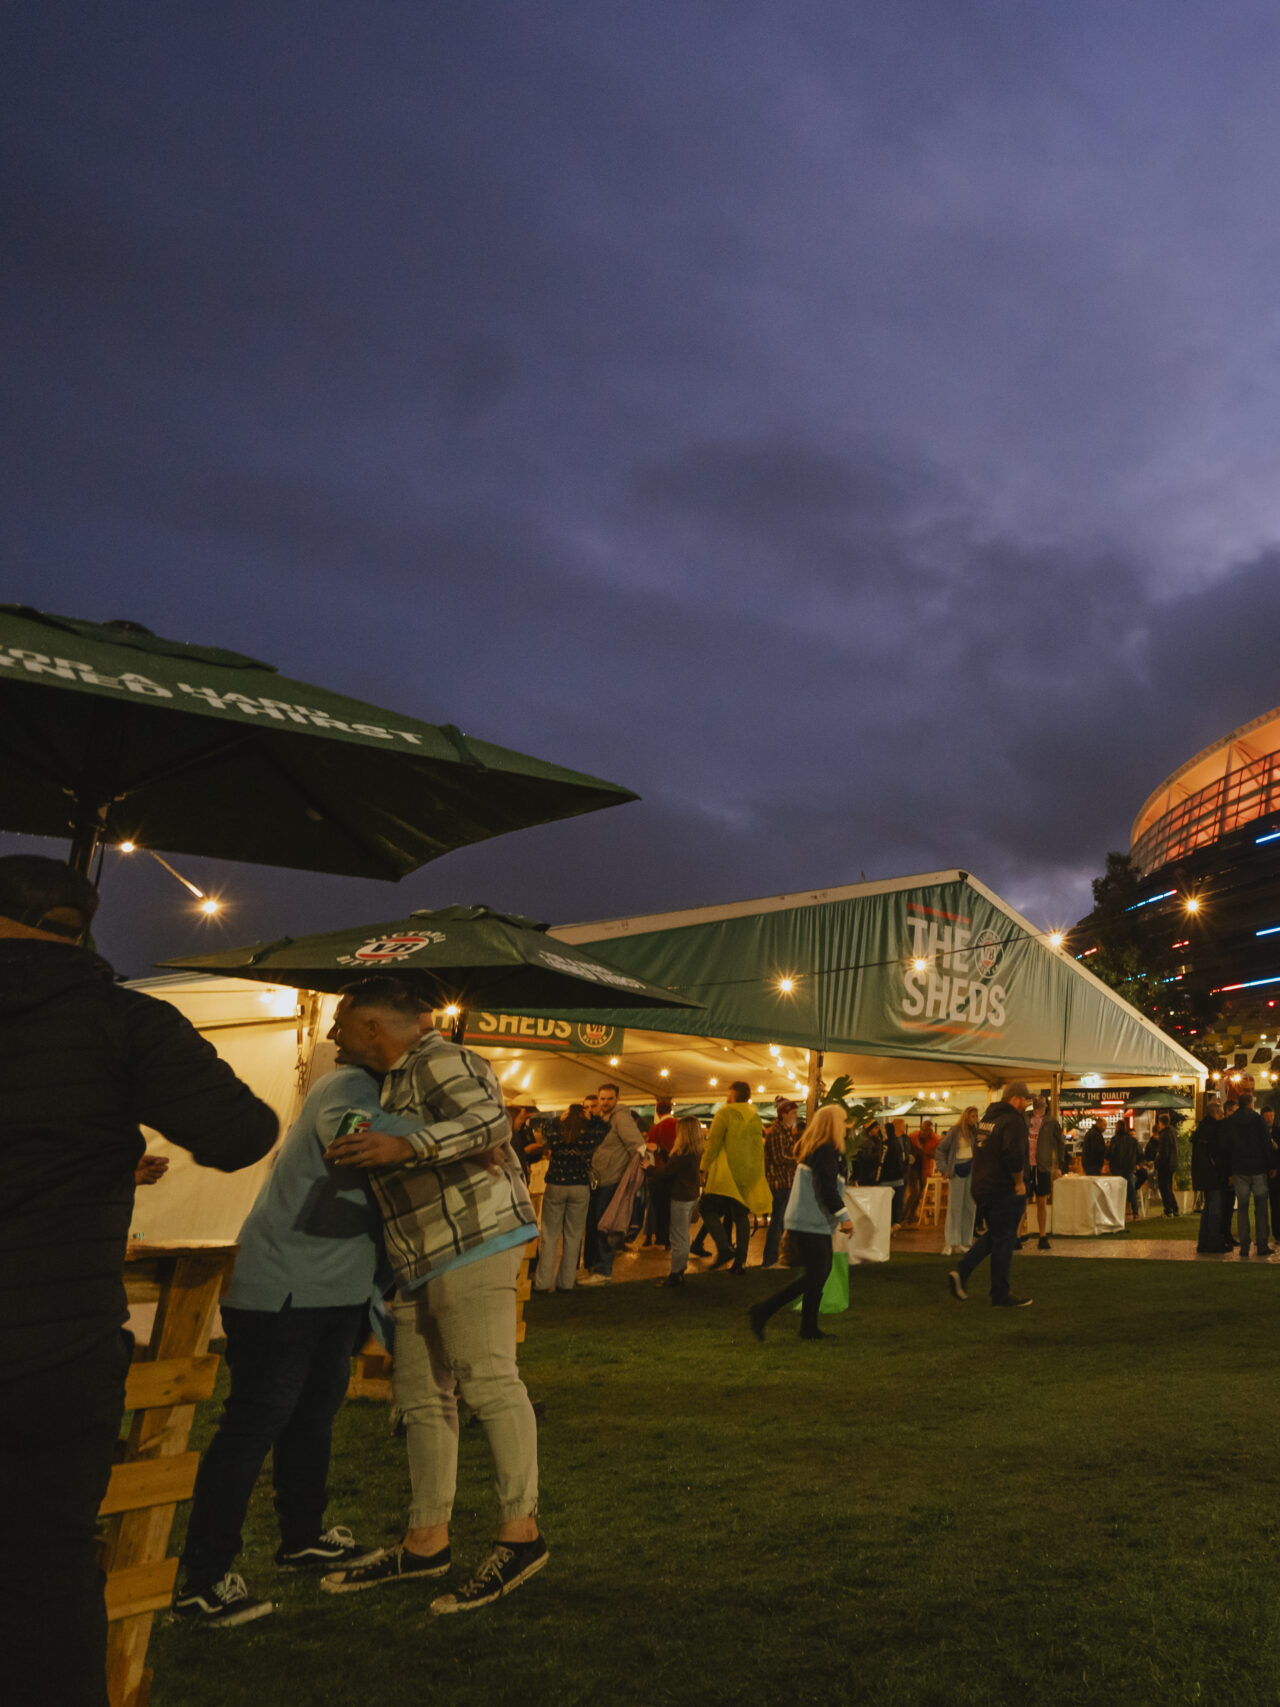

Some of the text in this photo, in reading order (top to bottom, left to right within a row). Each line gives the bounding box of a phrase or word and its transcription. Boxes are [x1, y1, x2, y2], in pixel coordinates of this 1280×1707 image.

[0, 645, 93, 672] OR
[906, 916, 972, 973] THE
[902, 969, 1006, 1027] SHEDS
[478, 1012, 572, 1039] SHEDS
[1101, 1091, 1131, 1100] QUALITY
